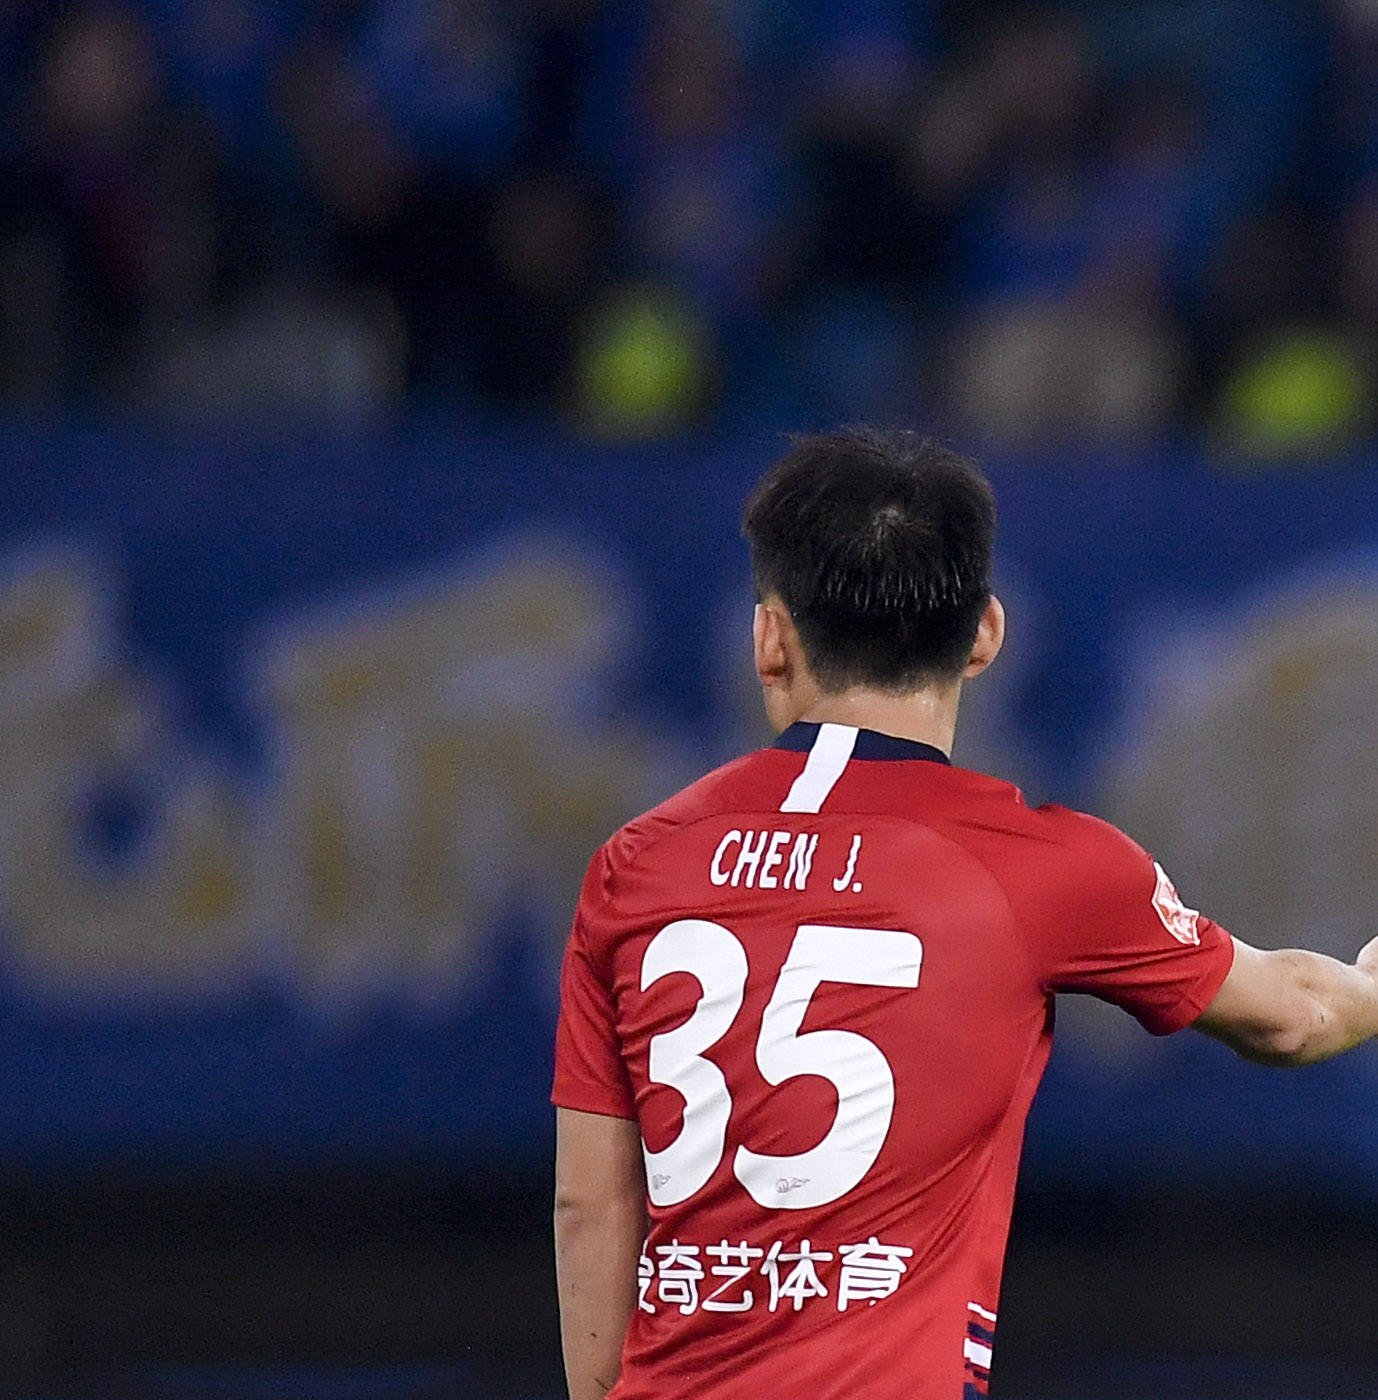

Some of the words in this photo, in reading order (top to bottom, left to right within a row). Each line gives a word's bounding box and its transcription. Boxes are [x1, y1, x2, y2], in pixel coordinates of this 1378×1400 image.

[709, 829, 820, 890] CHEN
[832, 834, 864, 893] J.
[640, 918, 924, 1210] 35
